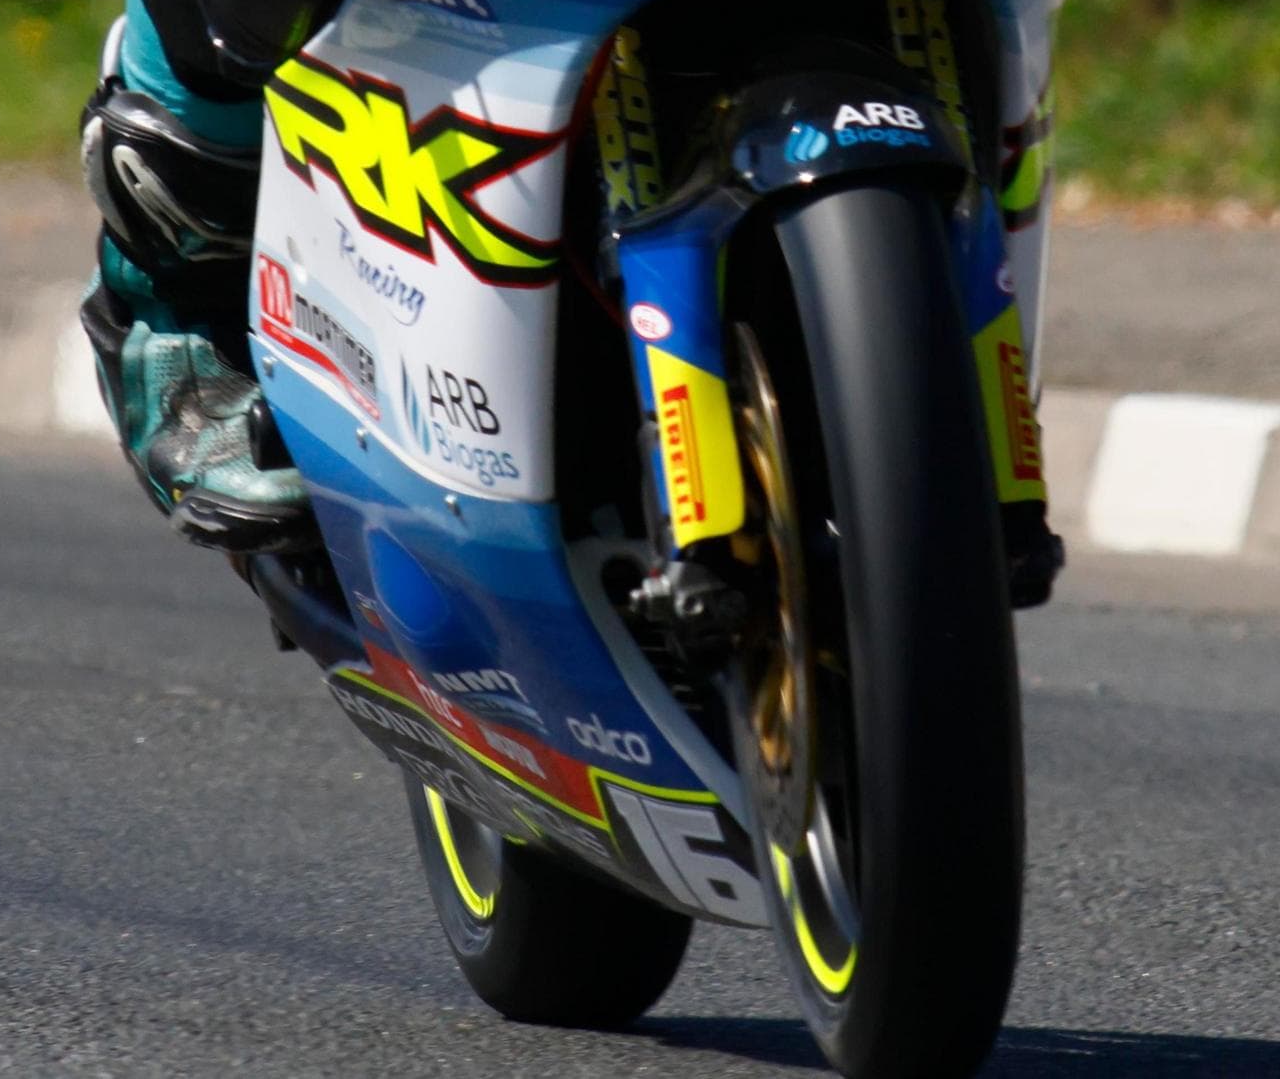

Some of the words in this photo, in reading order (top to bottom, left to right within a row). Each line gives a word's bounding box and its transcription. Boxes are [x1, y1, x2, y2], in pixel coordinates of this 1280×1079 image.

[833, 102, 925, 131] ARB
[836, 127, 929, 148] Biogas
[264, 55, 565, 277] RK
[334, 218, 426, 326] Racing
[427, 365, 501, 435] ARB
[432, 422, 520, 486] Biogas
[661, 384, 706, 524] PIRELLI
[433, 670, 529, 703] NMT
[608, 782, 775, 928] 16
